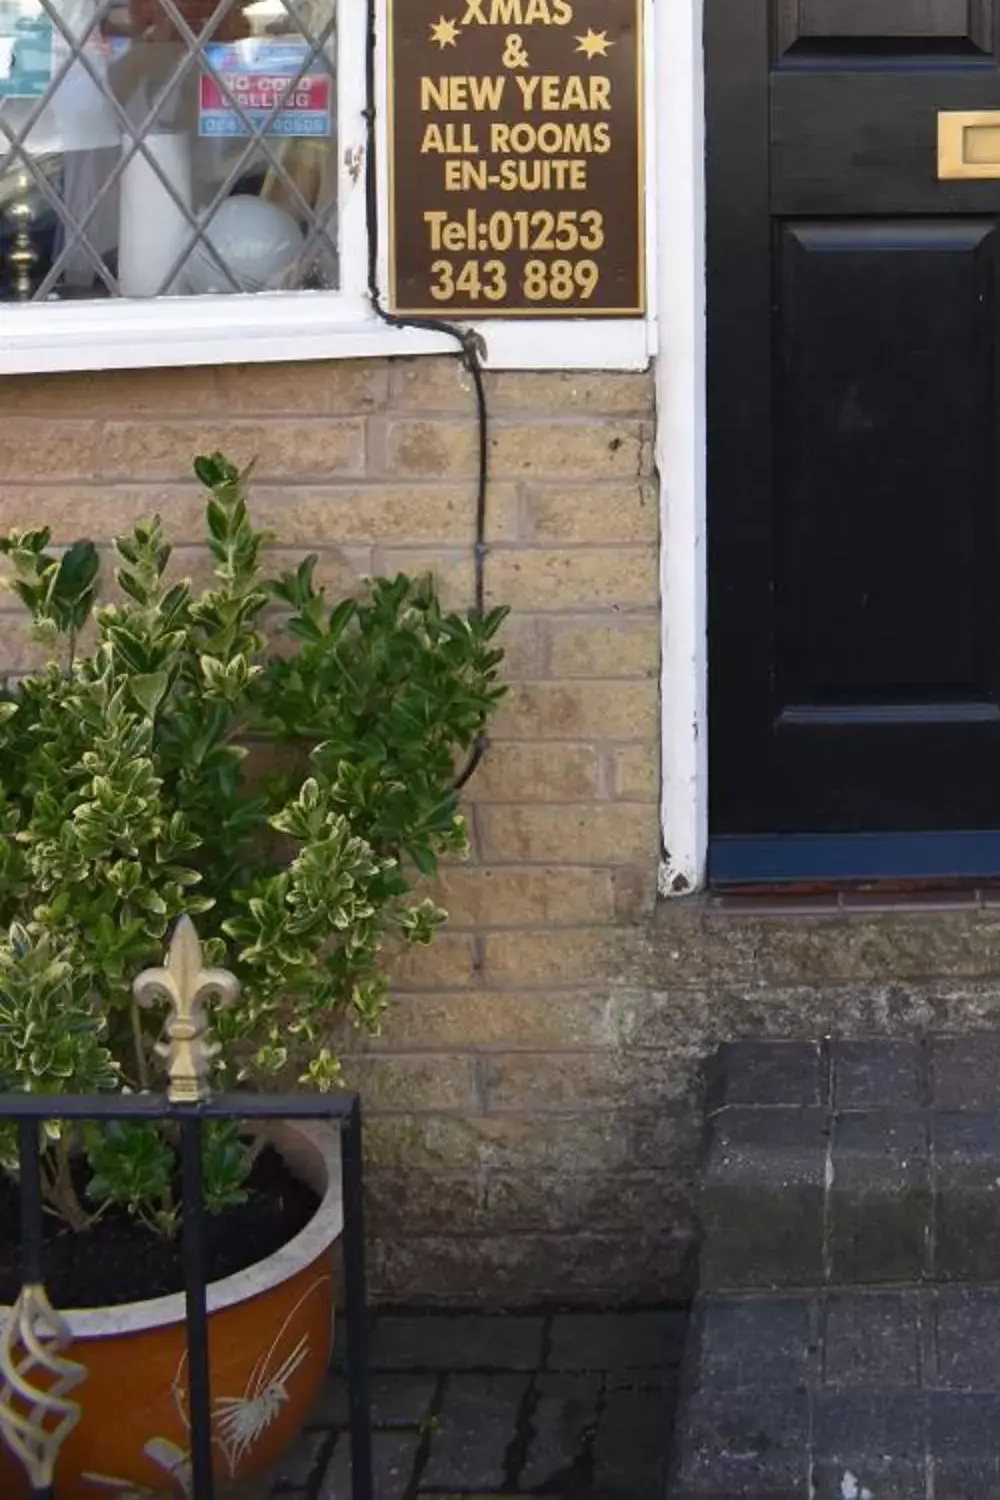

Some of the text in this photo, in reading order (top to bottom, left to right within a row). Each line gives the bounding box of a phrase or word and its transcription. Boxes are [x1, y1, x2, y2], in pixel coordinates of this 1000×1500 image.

[502, 33, 530, 69] &
[420, 76, 612, 111] NEW YEAR
[420, 123, 612, 154] ALL ROOMS
[445, 160, 587, 191] EN-SUITE
[423, 208, 605, 251] Tel:01253
[430, 260, 599, 300] 343 889
